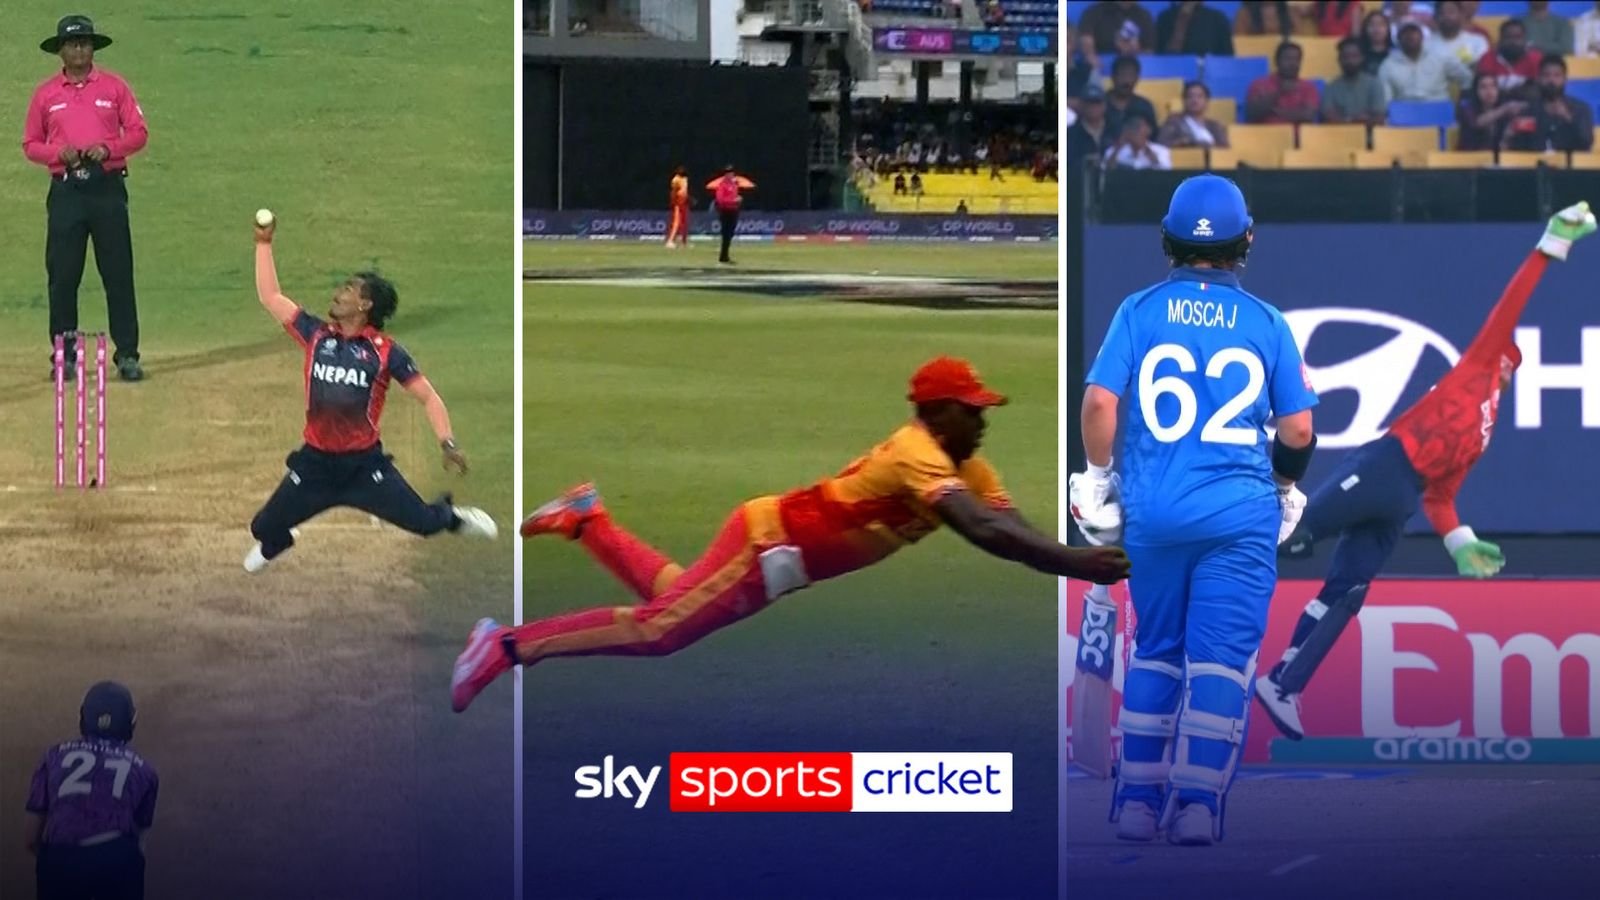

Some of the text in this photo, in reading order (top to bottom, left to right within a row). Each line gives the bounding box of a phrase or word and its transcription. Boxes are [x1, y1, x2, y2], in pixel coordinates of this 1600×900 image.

[614, 219, 667, 232] WORLD
[849, 219, 900, 232] WORLD
[964, 219, 1015, 232] WORLD
[1167, 298, 1238, 329] MOSCA J
[313, 361, 369, 388] NEPAL
[1514, 325, 1600, 429] H
[1138, 342, 1266, 446] 62
[1081, 600, 1110, 669] DSC
[1356, 604, 1600, 739] Em
[1373, 737, 1533, 761] aramco
[58, 750, 132, 799] 27
